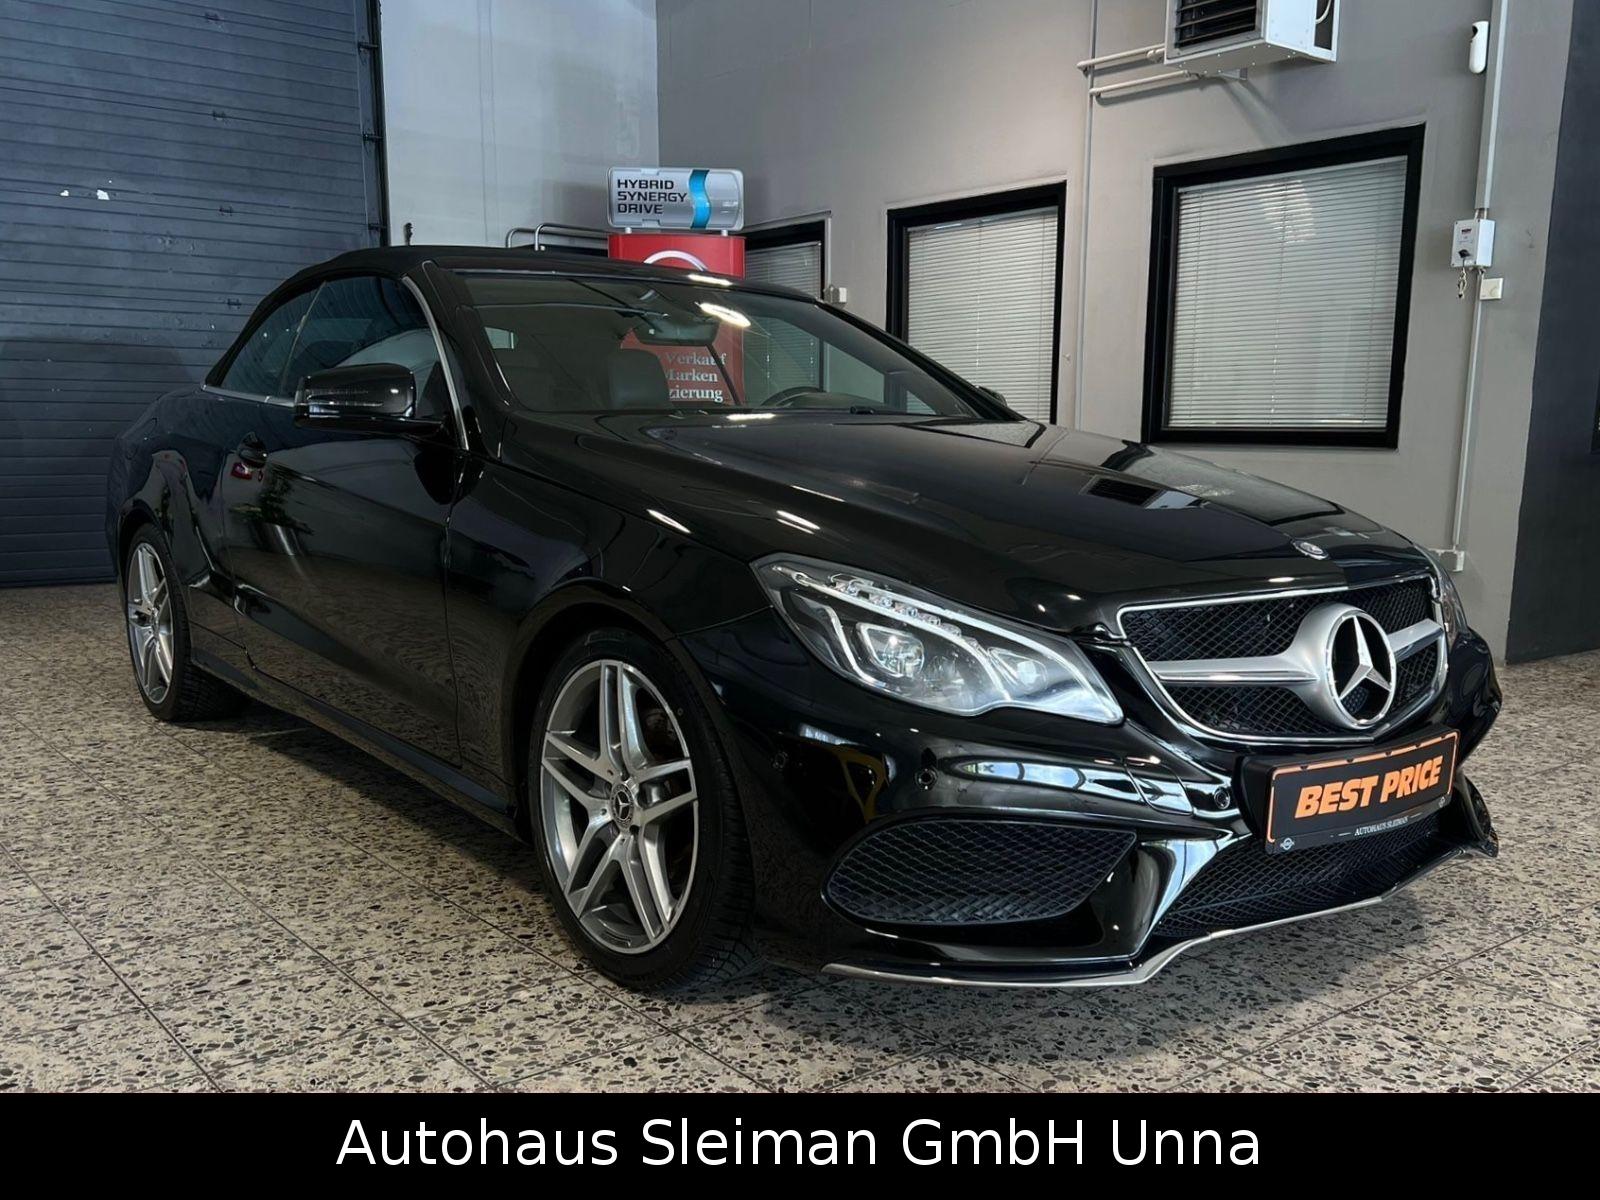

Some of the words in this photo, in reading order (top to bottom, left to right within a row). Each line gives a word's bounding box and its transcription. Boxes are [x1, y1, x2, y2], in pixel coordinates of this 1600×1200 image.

[617, 179, 674, 190] HYBRID
[617, 191, 688, 203] SYNERGY
[617, 203, 663, 214] DRIVE
[1294, 775, 1379, 819] BEST
[1380, 755, 1443, 803] PRICE
